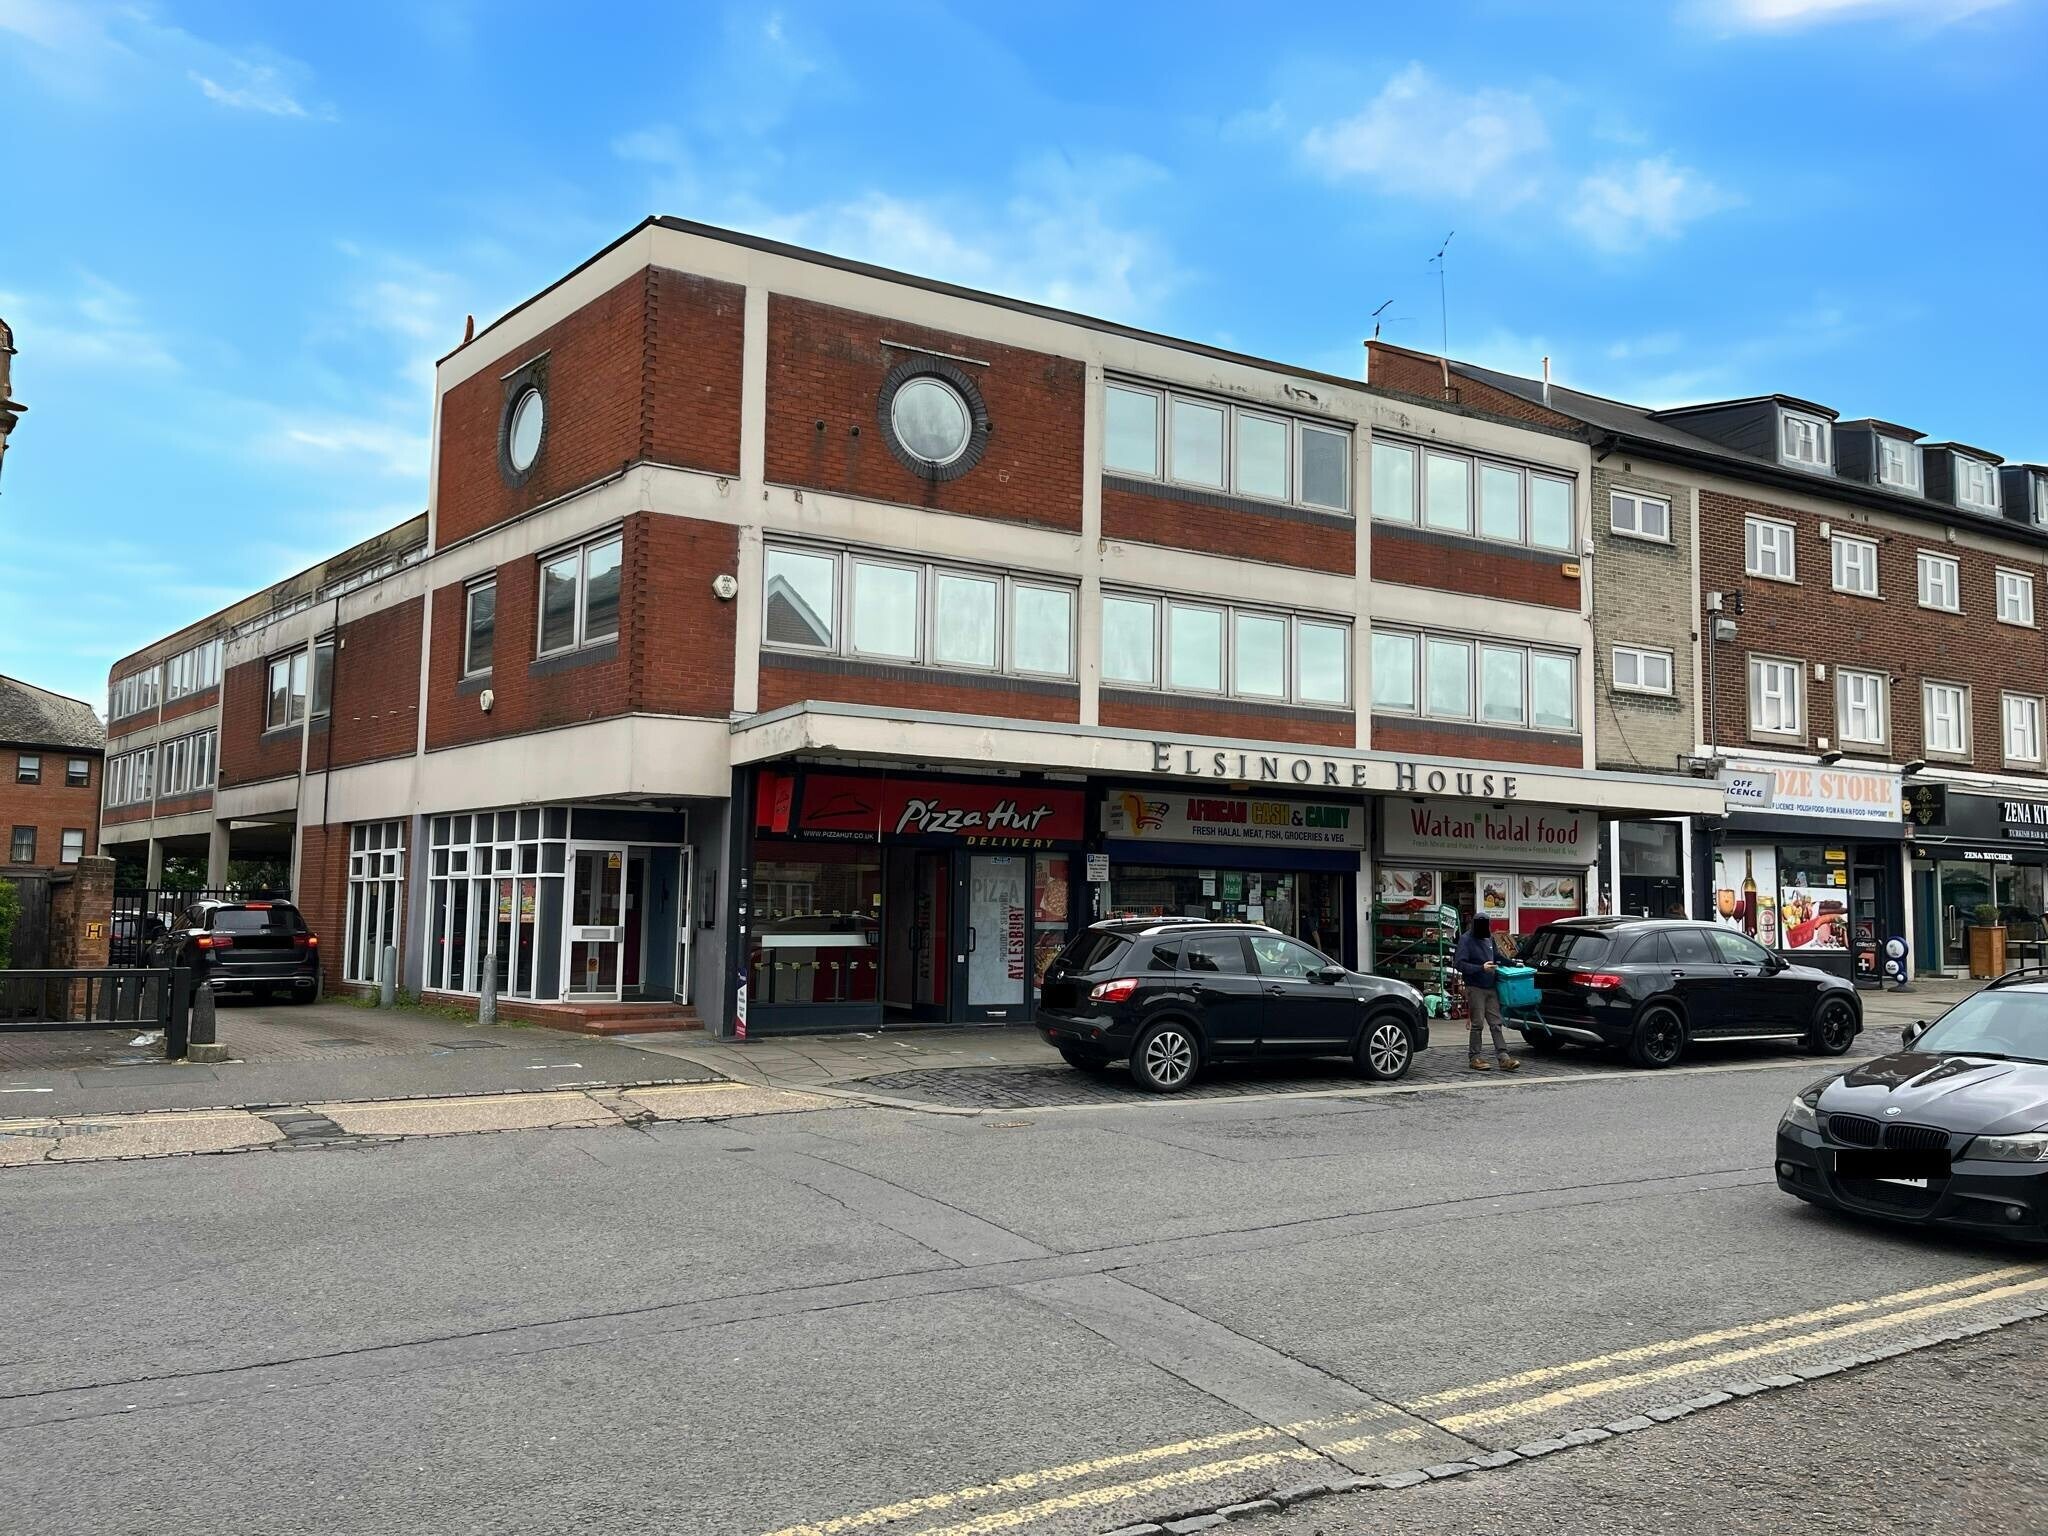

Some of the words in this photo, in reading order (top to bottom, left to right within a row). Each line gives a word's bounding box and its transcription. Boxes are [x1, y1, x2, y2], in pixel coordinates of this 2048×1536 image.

[1151, 742, 1366, 786] ELSINORE
[1396, 761, 1518, 798] HOUSE
[1726, 787, 1763, 798] ICENCE
[1733, 779, 1753, 788] OFF
[1819, 772, 1893, 803] STORE
[896, 800, 983, 834] Pizza
[986, 800, 1054, 831] Hut
[1186, 798, 1248, 824] AFRICAN
[1251, 801, 1291, 826] CASH
[1291, 810, 1304, 827] &
[1305, 805, 1351, 829] CARRY
[1775, 803, 1795, 811] LICENCE
[2004, 802, 2031, 823] ZENA
[803, 829, 875, 840] WWW.PIZZAHUT.CO.UK
[1192, 826, 1216, 836] FRESH
[1217, 827, 1241, 838] HALAL
[1243, 829, 1264, 840] MEAT,
[1265, 830, 1283, 841] FISH,
[1284, 831, 1323, 842] GROCERIES
[1324, 832, 1330, 842] &
[1331, 833, 1345, 843] VEG
[1410, 808, 1475, 839] Watan
[1485, 813, 1530, 842] halal
[1537, 817, 1578, 845] food
[966, 836, 1054, 849] DELIVERY
[1008, 905, 1024, 980] AYLESBURY
